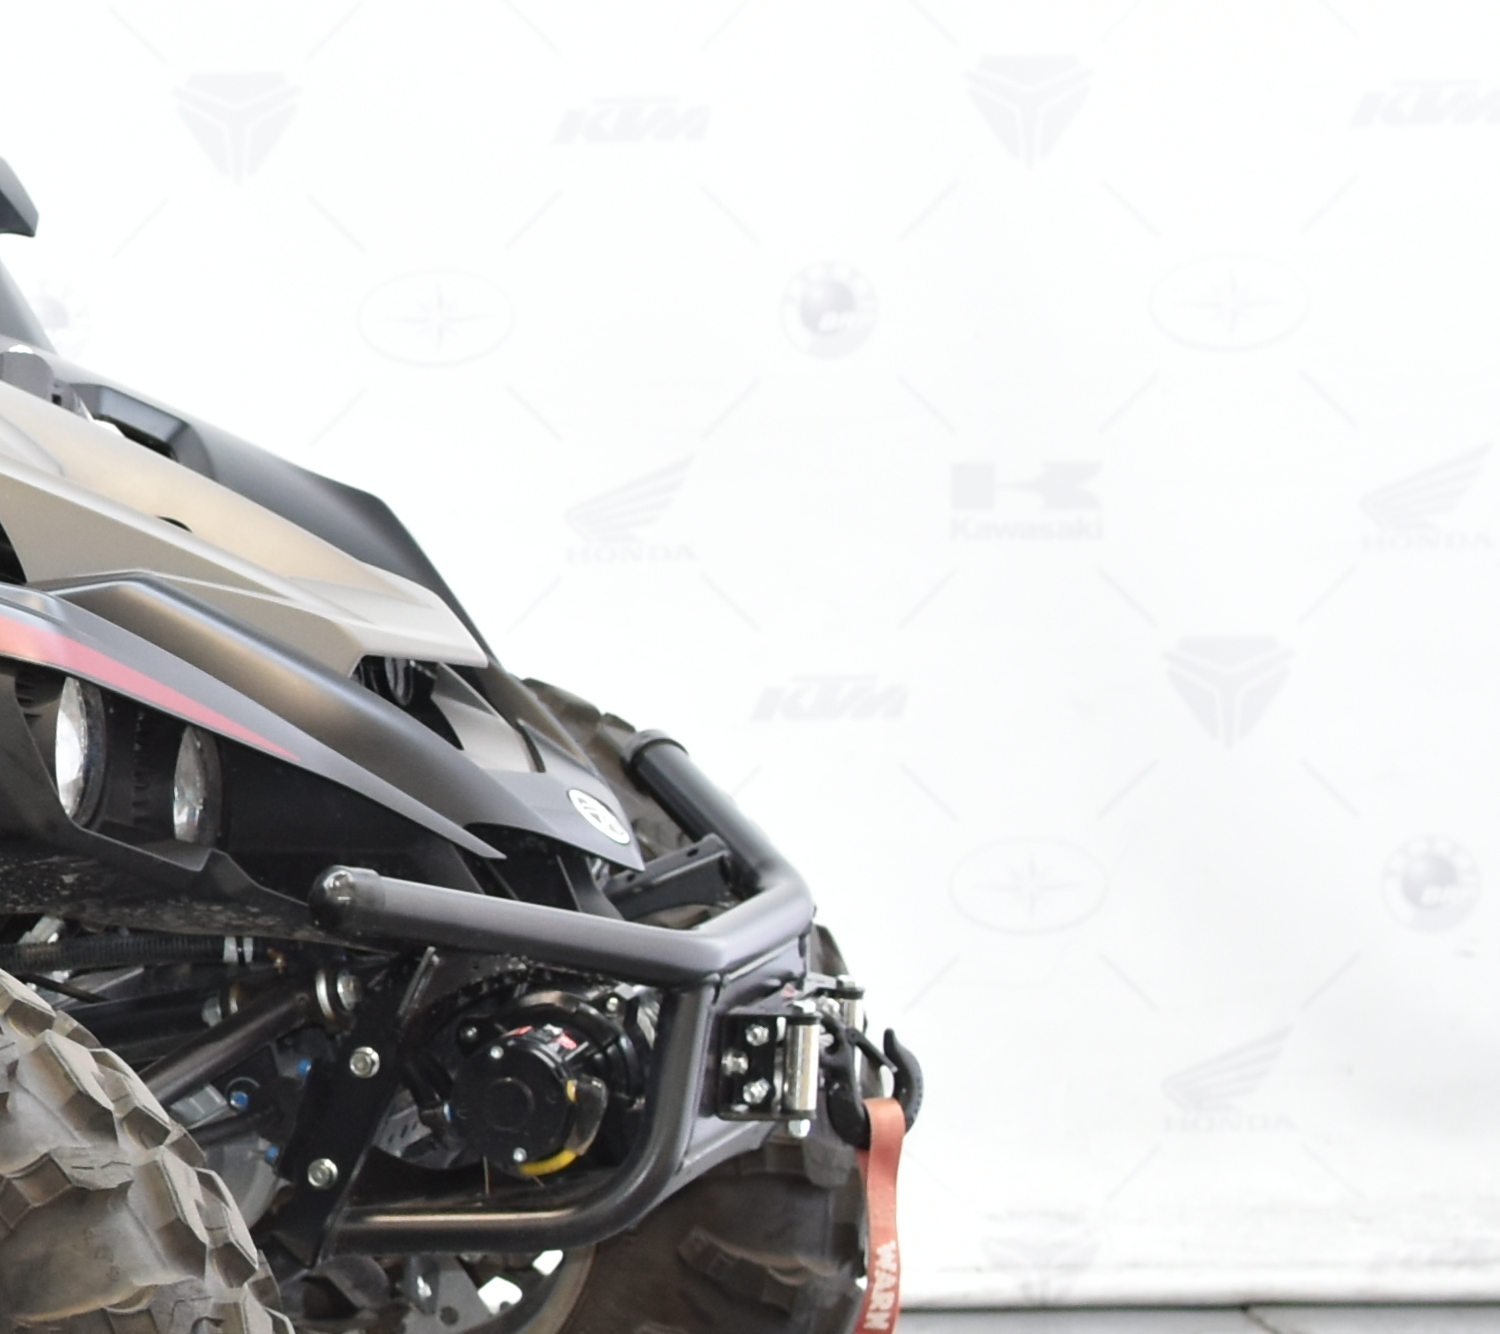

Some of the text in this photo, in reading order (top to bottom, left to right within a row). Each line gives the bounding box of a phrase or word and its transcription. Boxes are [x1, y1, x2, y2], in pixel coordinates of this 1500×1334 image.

[553, 96, 712, 145] KTM
[750, 675, 910, 722] KTM
[862, 1240, 897, 1331] WARN
